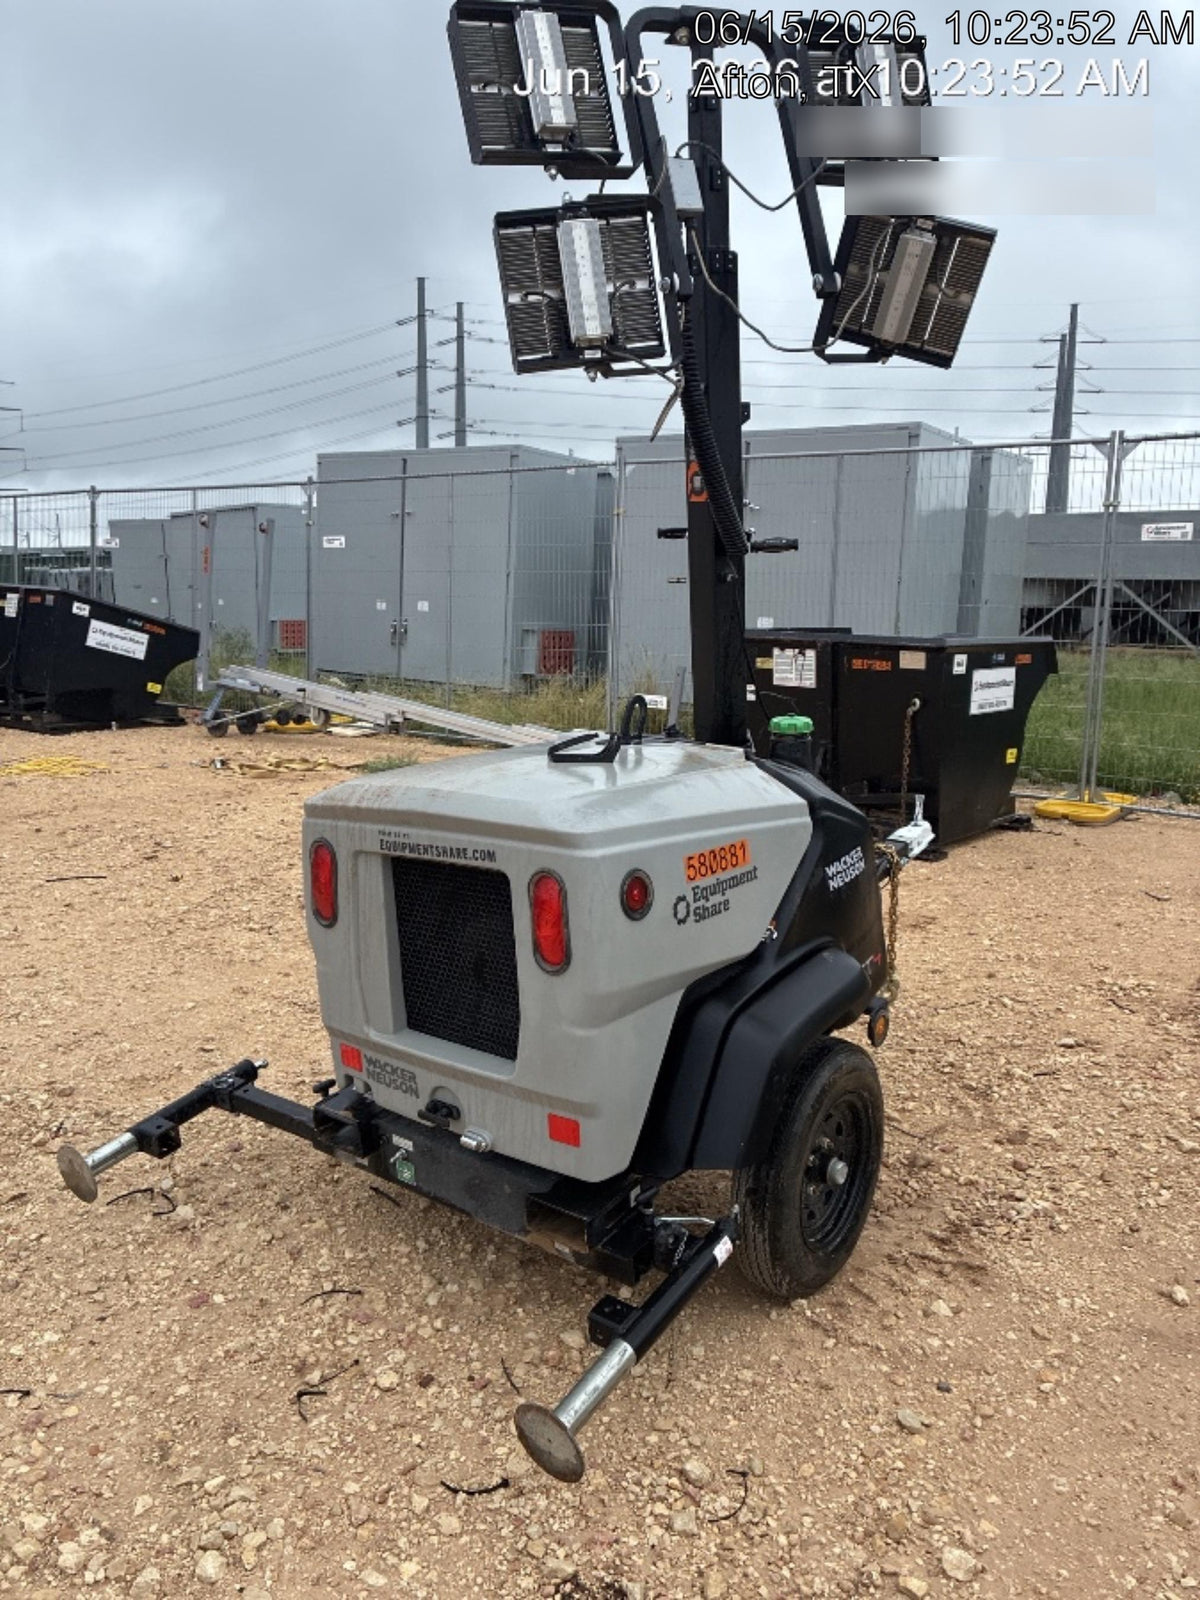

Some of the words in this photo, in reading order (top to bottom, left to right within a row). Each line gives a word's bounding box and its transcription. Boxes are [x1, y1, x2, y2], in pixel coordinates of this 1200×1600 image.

[686, 840, 747, 882] 580881
[824, 845, 864, 878] WACKER
[827, 858, 866, 892] NEUSON
[691, 865, 759, 904] Equipment
[692, 897, 731, 924] Share
[363, 1053, 417, 1083] WACKER
[366, 1068, 420, 1100] NEUSON
